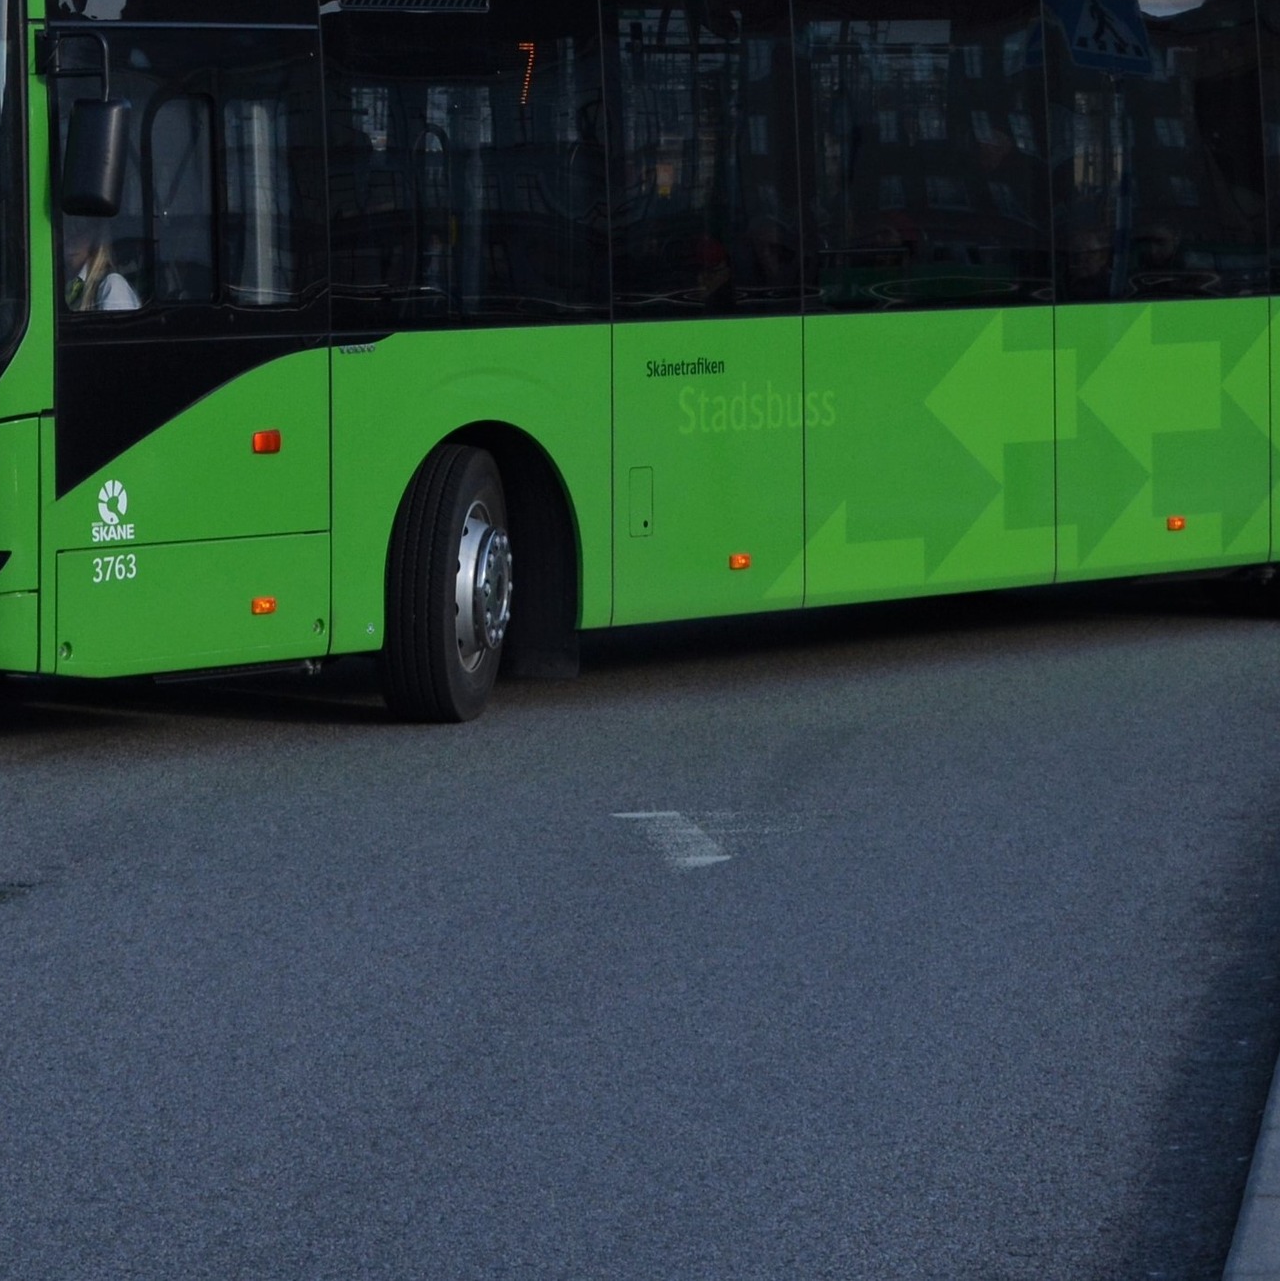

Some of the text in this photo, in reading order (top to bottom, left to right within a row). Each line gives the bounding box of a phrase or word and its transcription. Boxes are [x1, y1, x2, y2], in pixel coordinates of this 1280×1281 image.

[519, 43, 534, 105] 7
[646, 357, 725, 378] Skånetrafiken
[678, 380, 836, 435] Stadsbuss
[92, 554, 136, 583] 3763
